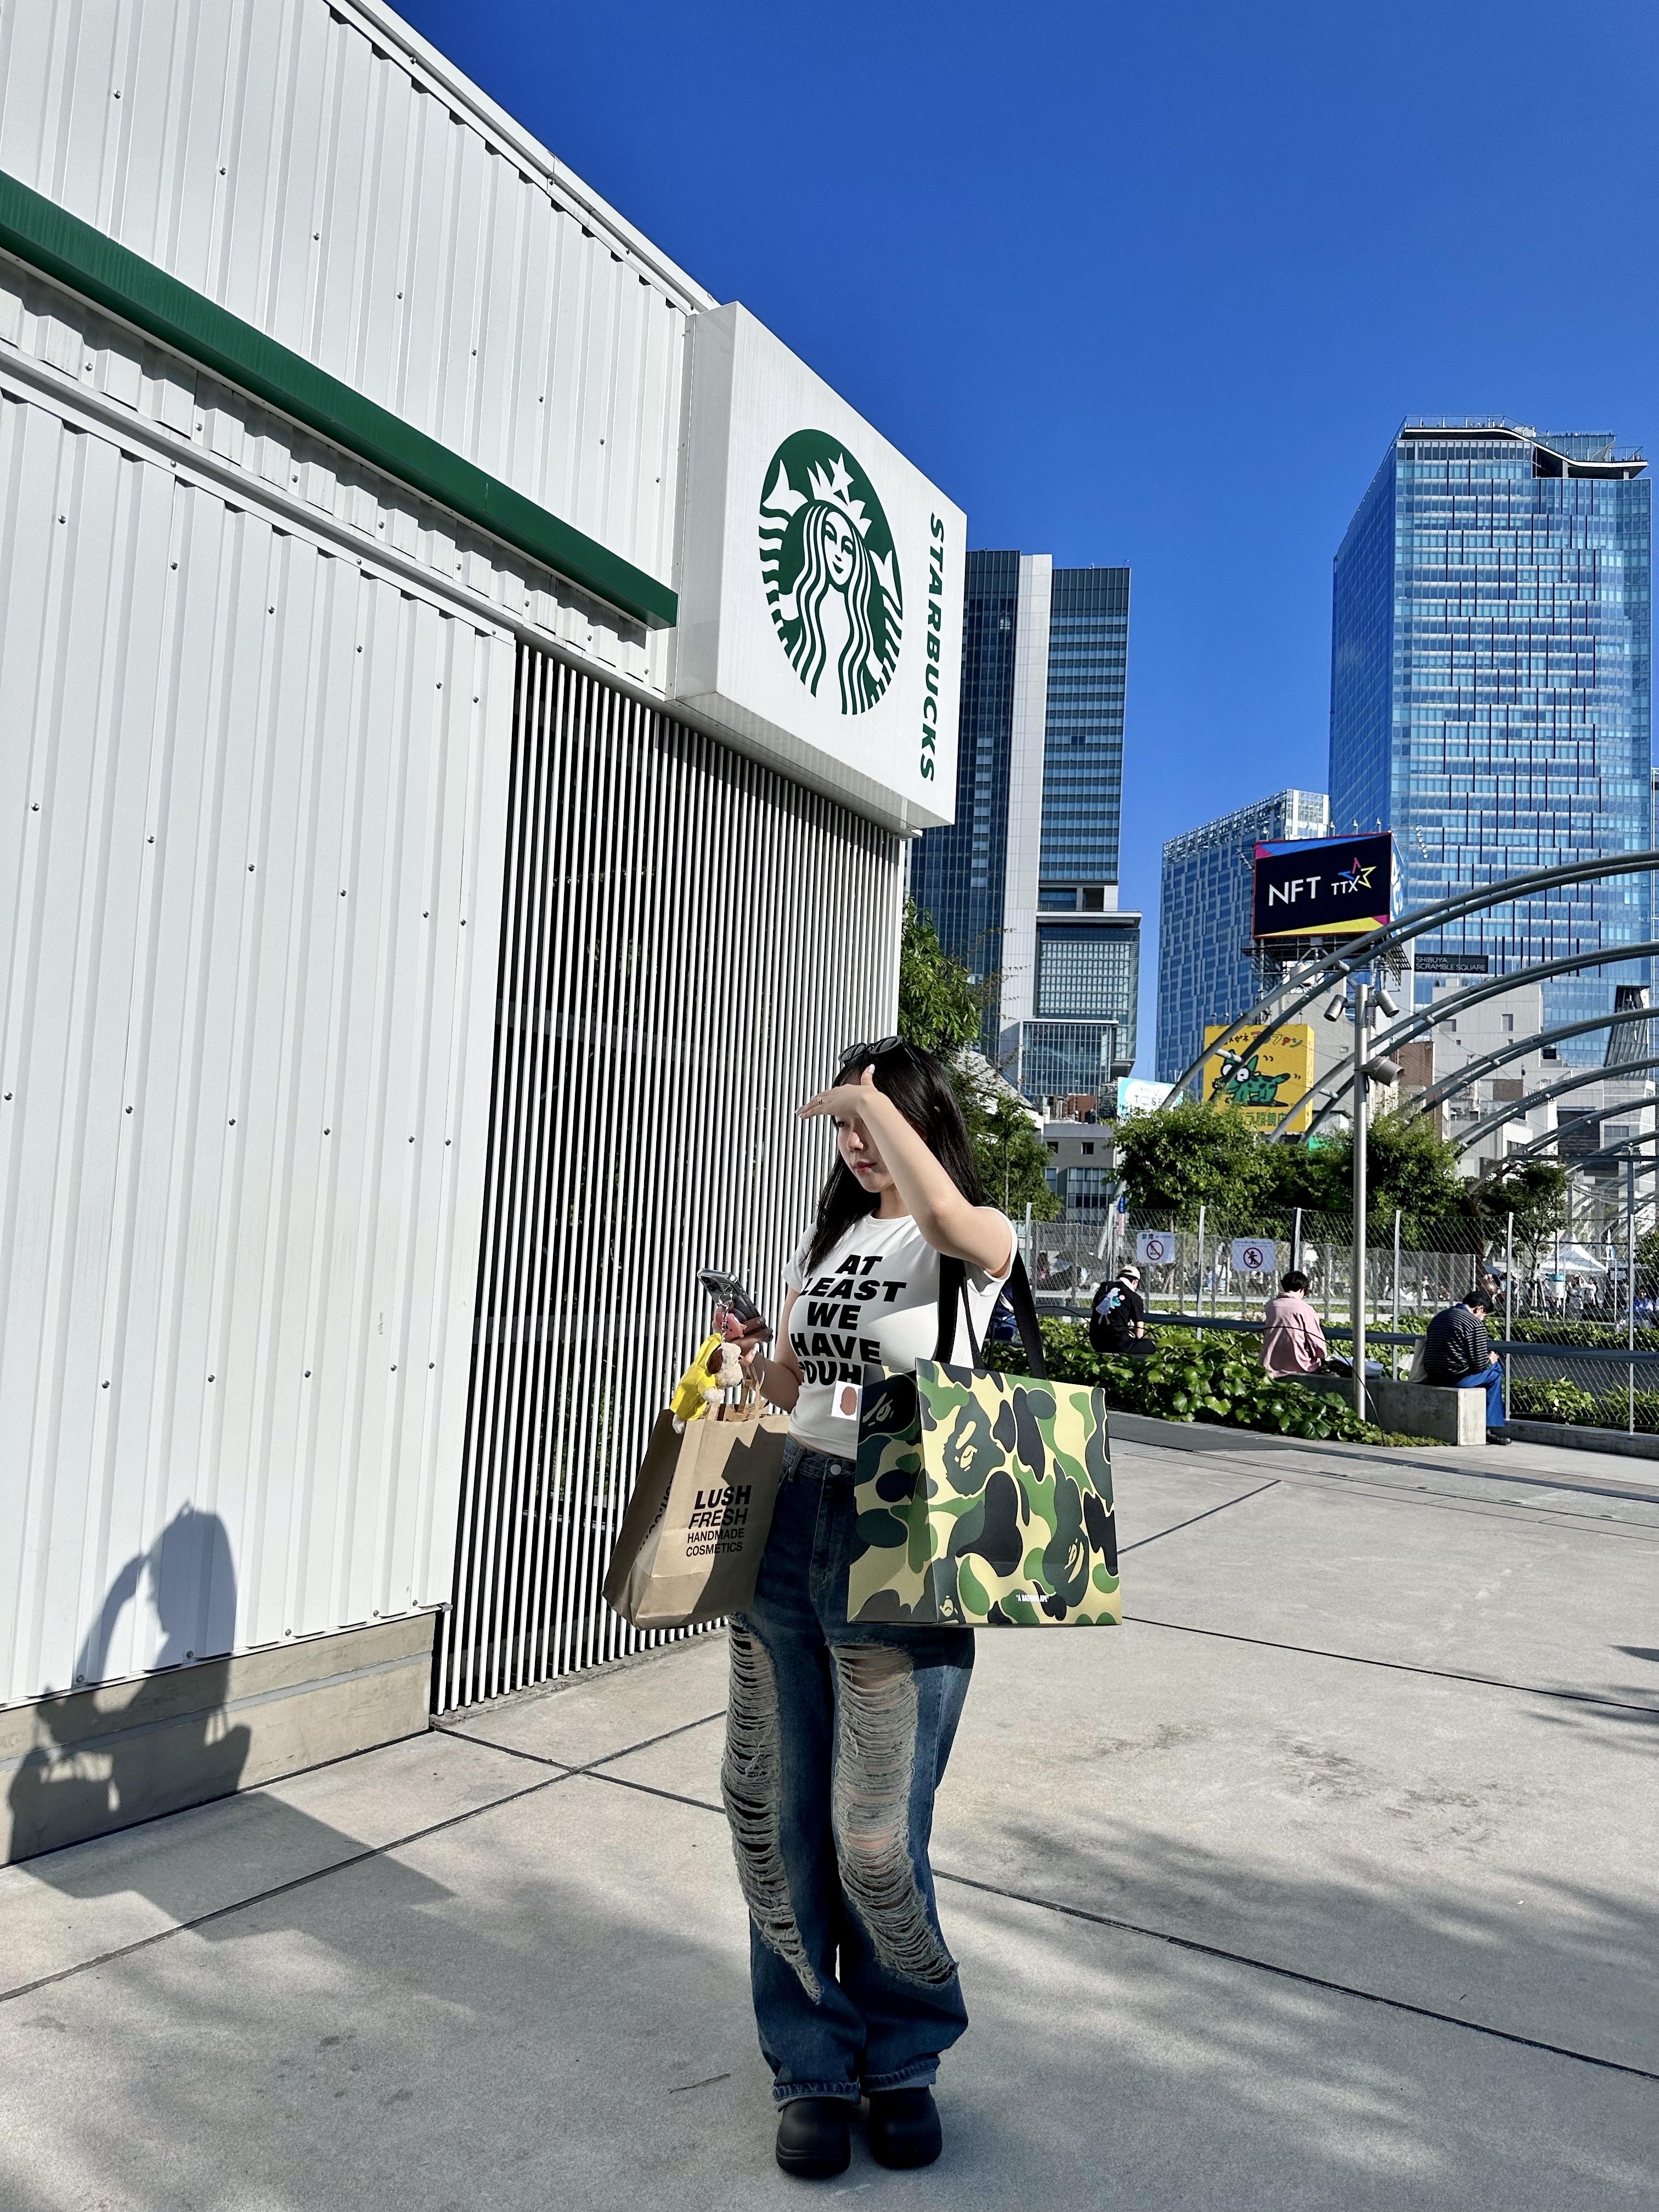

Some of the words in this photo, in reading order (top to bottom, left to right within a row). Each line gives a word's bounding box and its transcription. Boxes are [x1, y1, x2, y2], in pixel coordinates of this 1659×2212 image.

[920, 512, 944, 782] STARBUCKS
[1268, 876, 1321, 906] NFT
[1331, 875, 1361, 895] TTX
[834, 1254, 883, 1276] AT
[798, 1277, 907, 1302] LEAST
[807, 1301, 861, 1330] WE
[790, 1333, 882, 1365] HAVE
[694, 1485, 752, 1510] LUSH
[688, 1508, 748, 1530] FRESH
[687, 1528, 744, 1543] HANDMADE
[686, 1542, 743, 1557] COSMETICS
